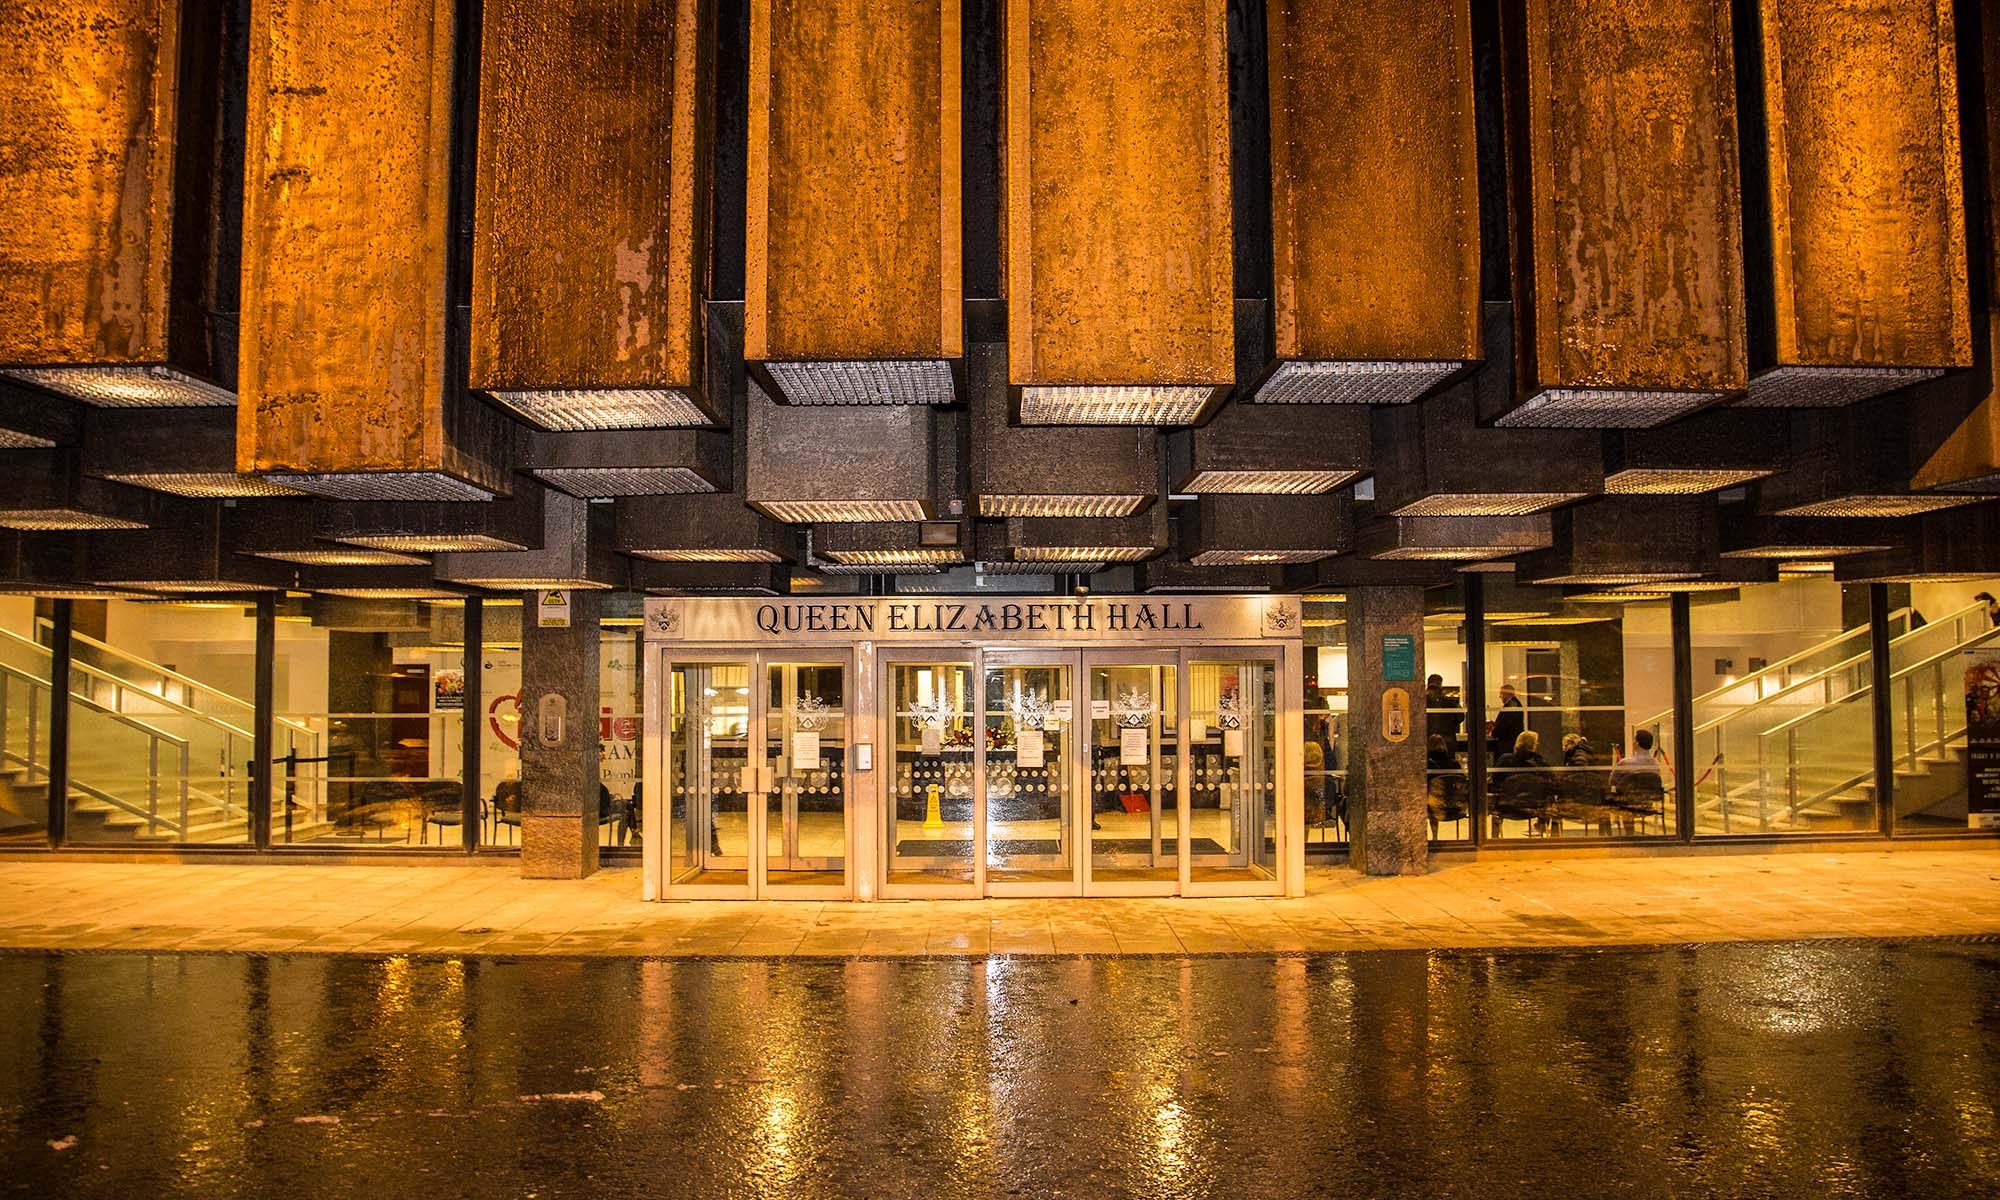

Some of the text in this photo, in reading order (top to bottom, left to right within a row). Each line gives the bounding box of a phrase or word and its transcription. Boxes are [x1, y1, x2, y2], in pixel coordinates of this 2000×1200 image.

[756, 603, 1204, 634] QUEEN ELIZABETH HALL
